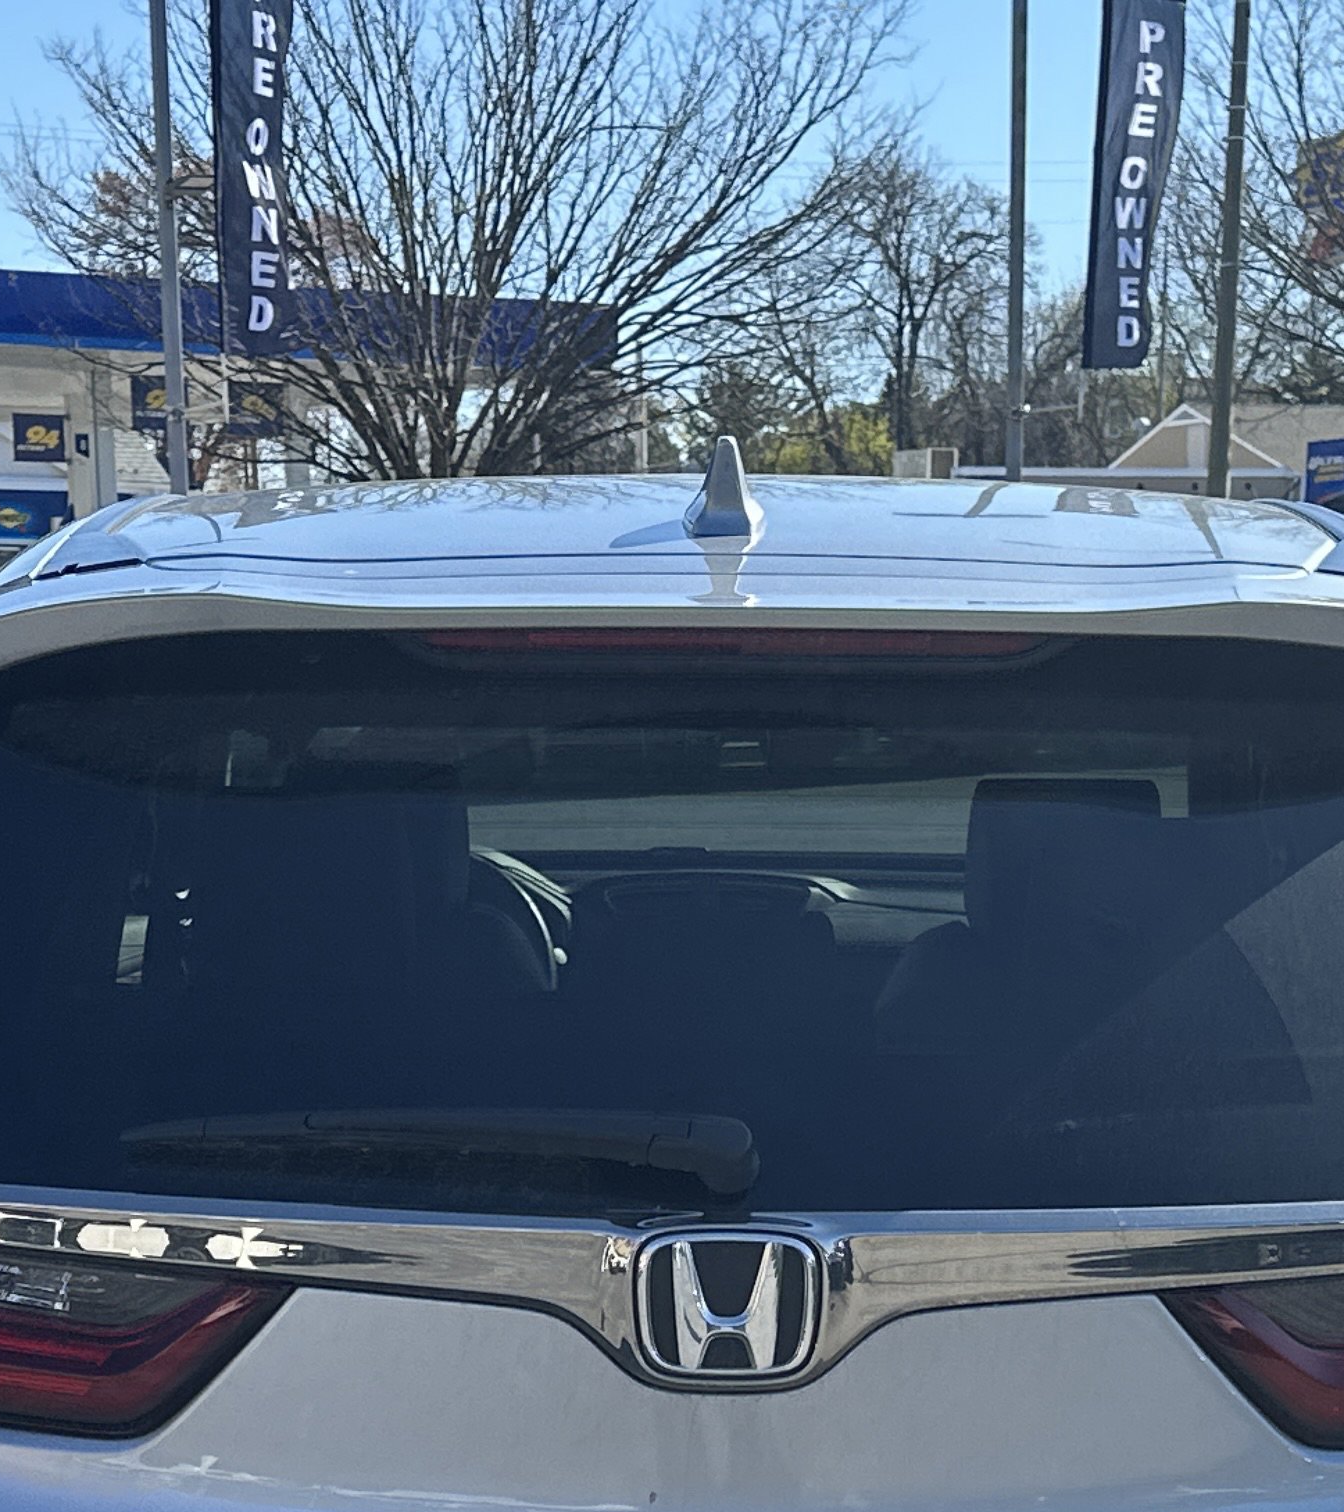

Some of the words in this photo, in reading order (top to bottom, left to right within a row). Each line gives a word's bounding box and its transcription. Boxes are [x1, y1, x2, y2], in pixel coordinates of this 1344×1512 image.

[251, 0, 277, 98] RE
[1128, 19, 1165, 138] PRE
[242, 117, 279, 333] OWNED
[1113, 156, 1148, 348] OWNED
[26, 424, 61, 448] 94
